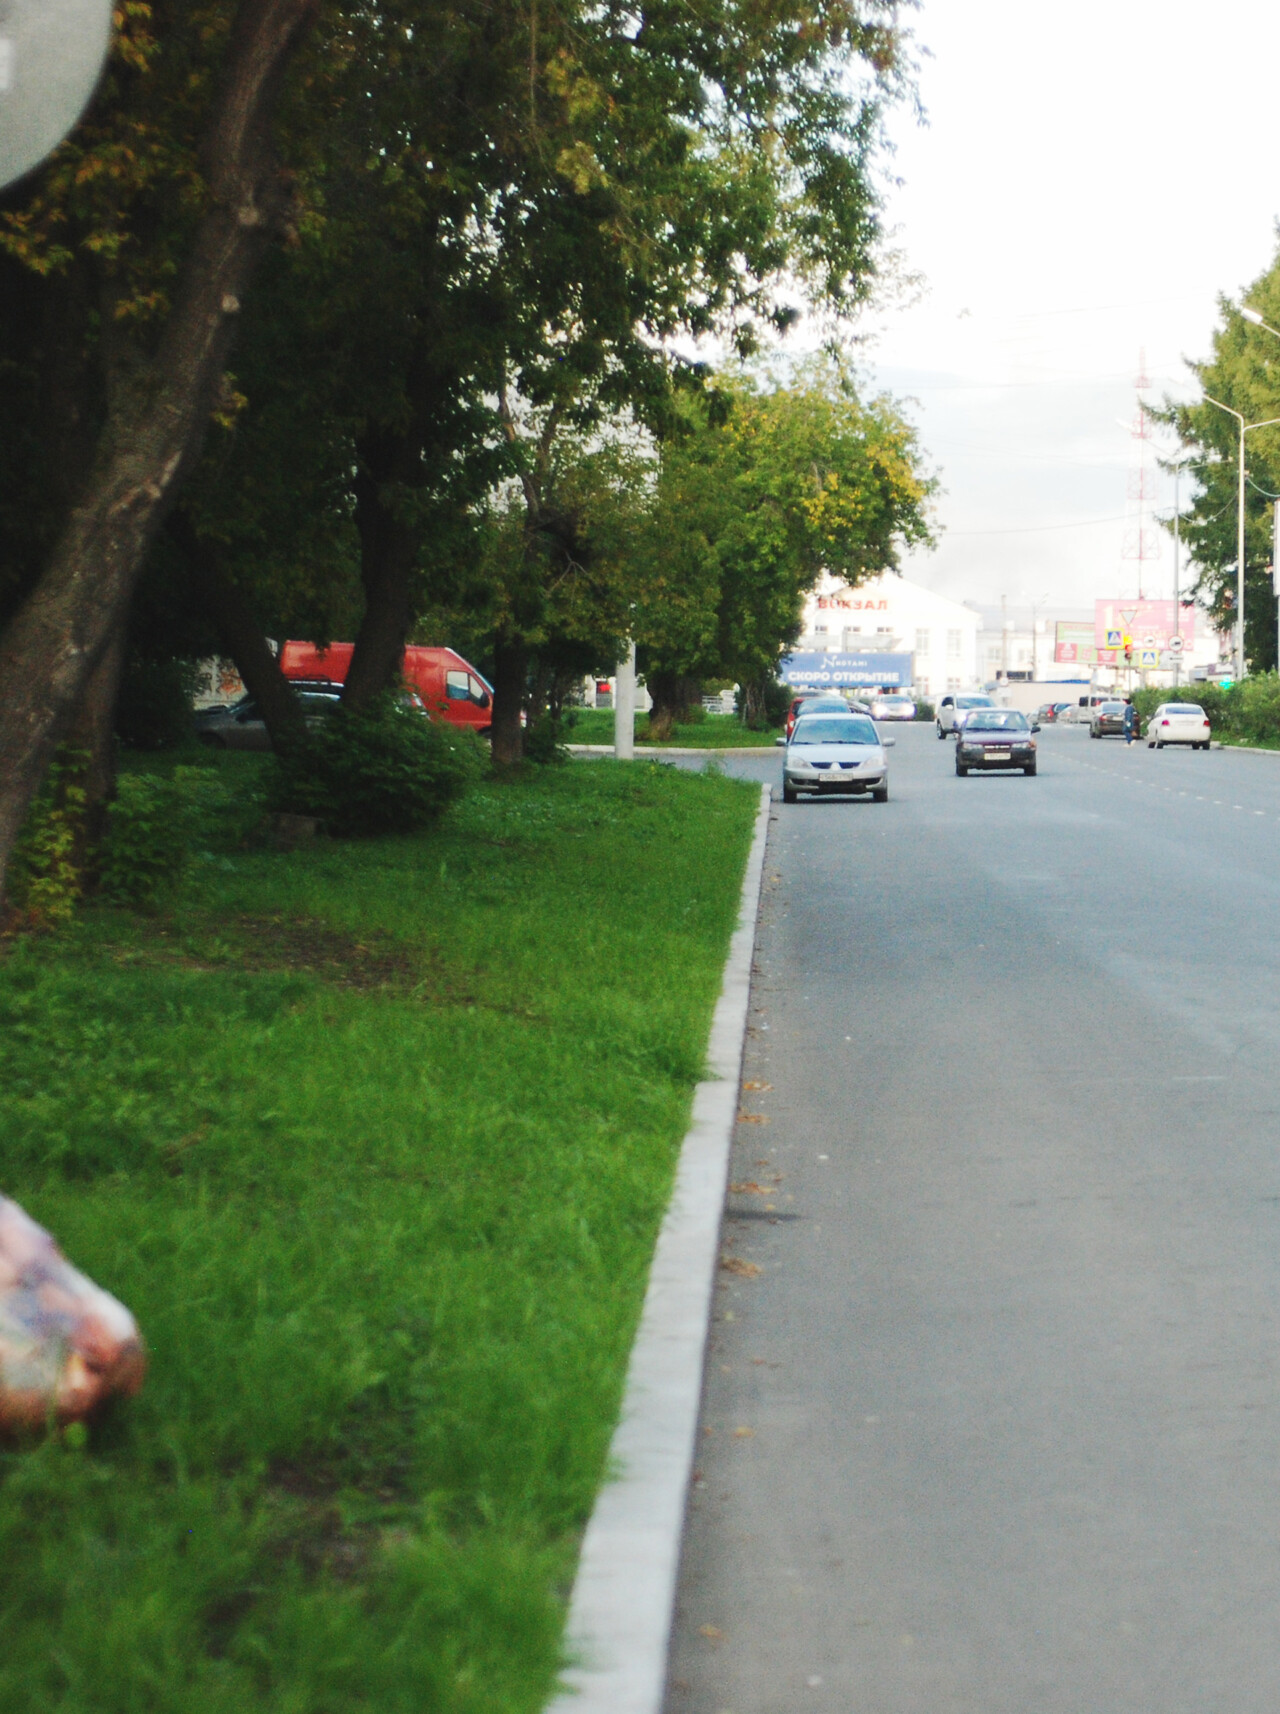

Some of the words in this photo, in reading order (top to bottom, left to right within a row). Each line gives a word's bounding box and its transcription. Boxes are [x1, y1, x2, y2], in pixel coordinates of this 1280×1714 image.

[819, 599, 888, 610] ВОКЗАЛ
[788, 671, 830, 682] СКОРО
[833, 671, 900, 682] ОТКРЫТИЕ
